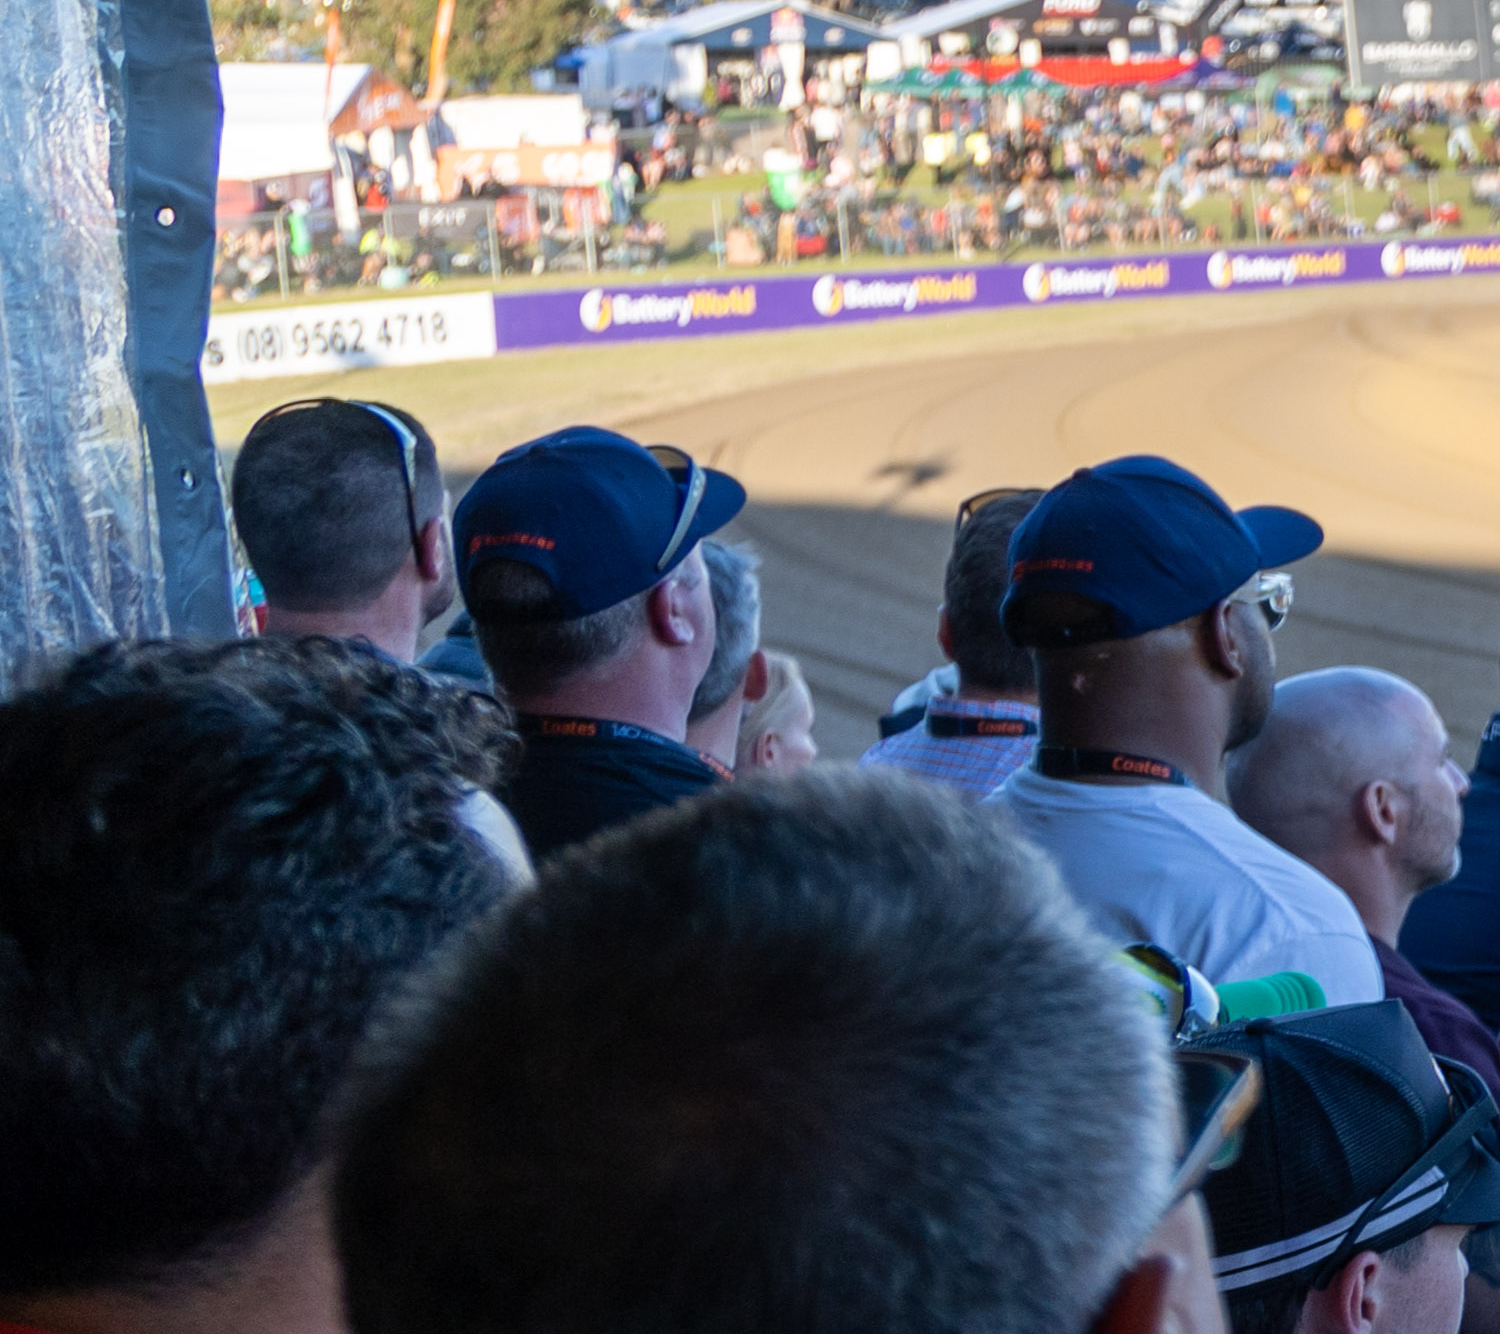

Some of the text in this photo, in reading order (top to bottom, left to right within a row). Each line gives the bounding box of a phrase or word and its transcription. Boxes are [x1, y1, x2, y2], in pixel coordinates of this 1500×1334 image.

[1050, 258, 1171, 299] BatteryWorld
[1231, 247, 1347, 285] BatteryWorld
[611, 284, 757, 328] BatteryWorld
[843, 271, 977, 312] BatteryWorld
[236, 327, 285, 364] (08)
[292, 320, 366, 356] 9562
[377, 311, 449, 345] 4718
[1111, 755, 1171, 779] Coates
